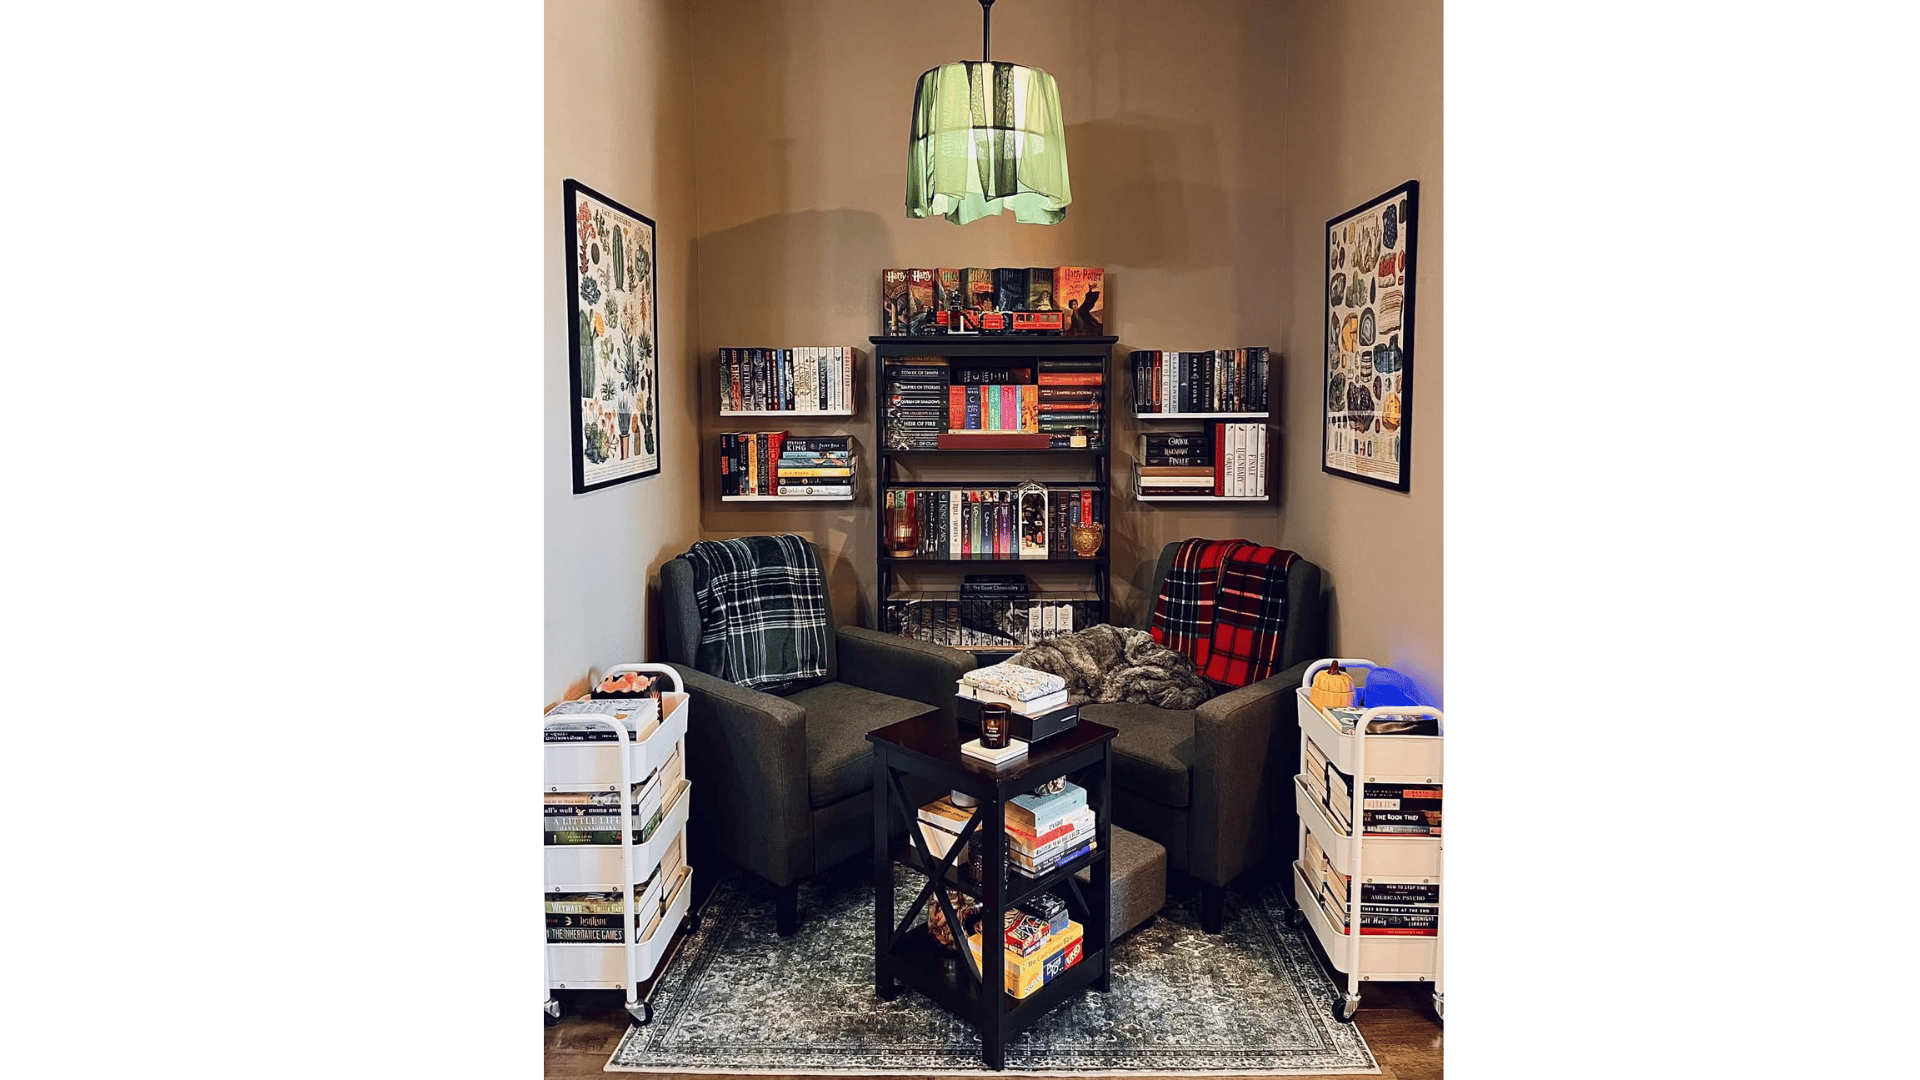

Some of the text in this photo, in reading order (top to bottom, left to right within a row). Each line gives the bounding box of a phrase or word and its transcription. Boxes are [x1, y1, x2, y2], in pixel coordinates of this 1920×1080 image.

[886, 270, 907, 283] Harry
[912, 270, 932, 283] Harry
[1169, 456, 1190, 465] FINALE
[1236, 447, 1246, 482] LEGENDARY
[1248, 454, 1257, 477] FINALE
[939, 523, 948, 543] SCARS
[559, 806, 573, 814] well
[553, 816, 622, 826] A LITTLE LIFE
[1387, 813, 1403, 821] BOOK
[551, 903, 583, 913] WEYWARD
[1372, 916, 1387, 926] Haig
[551, 928, 623, 940] THE INHERITANCE GAMES
